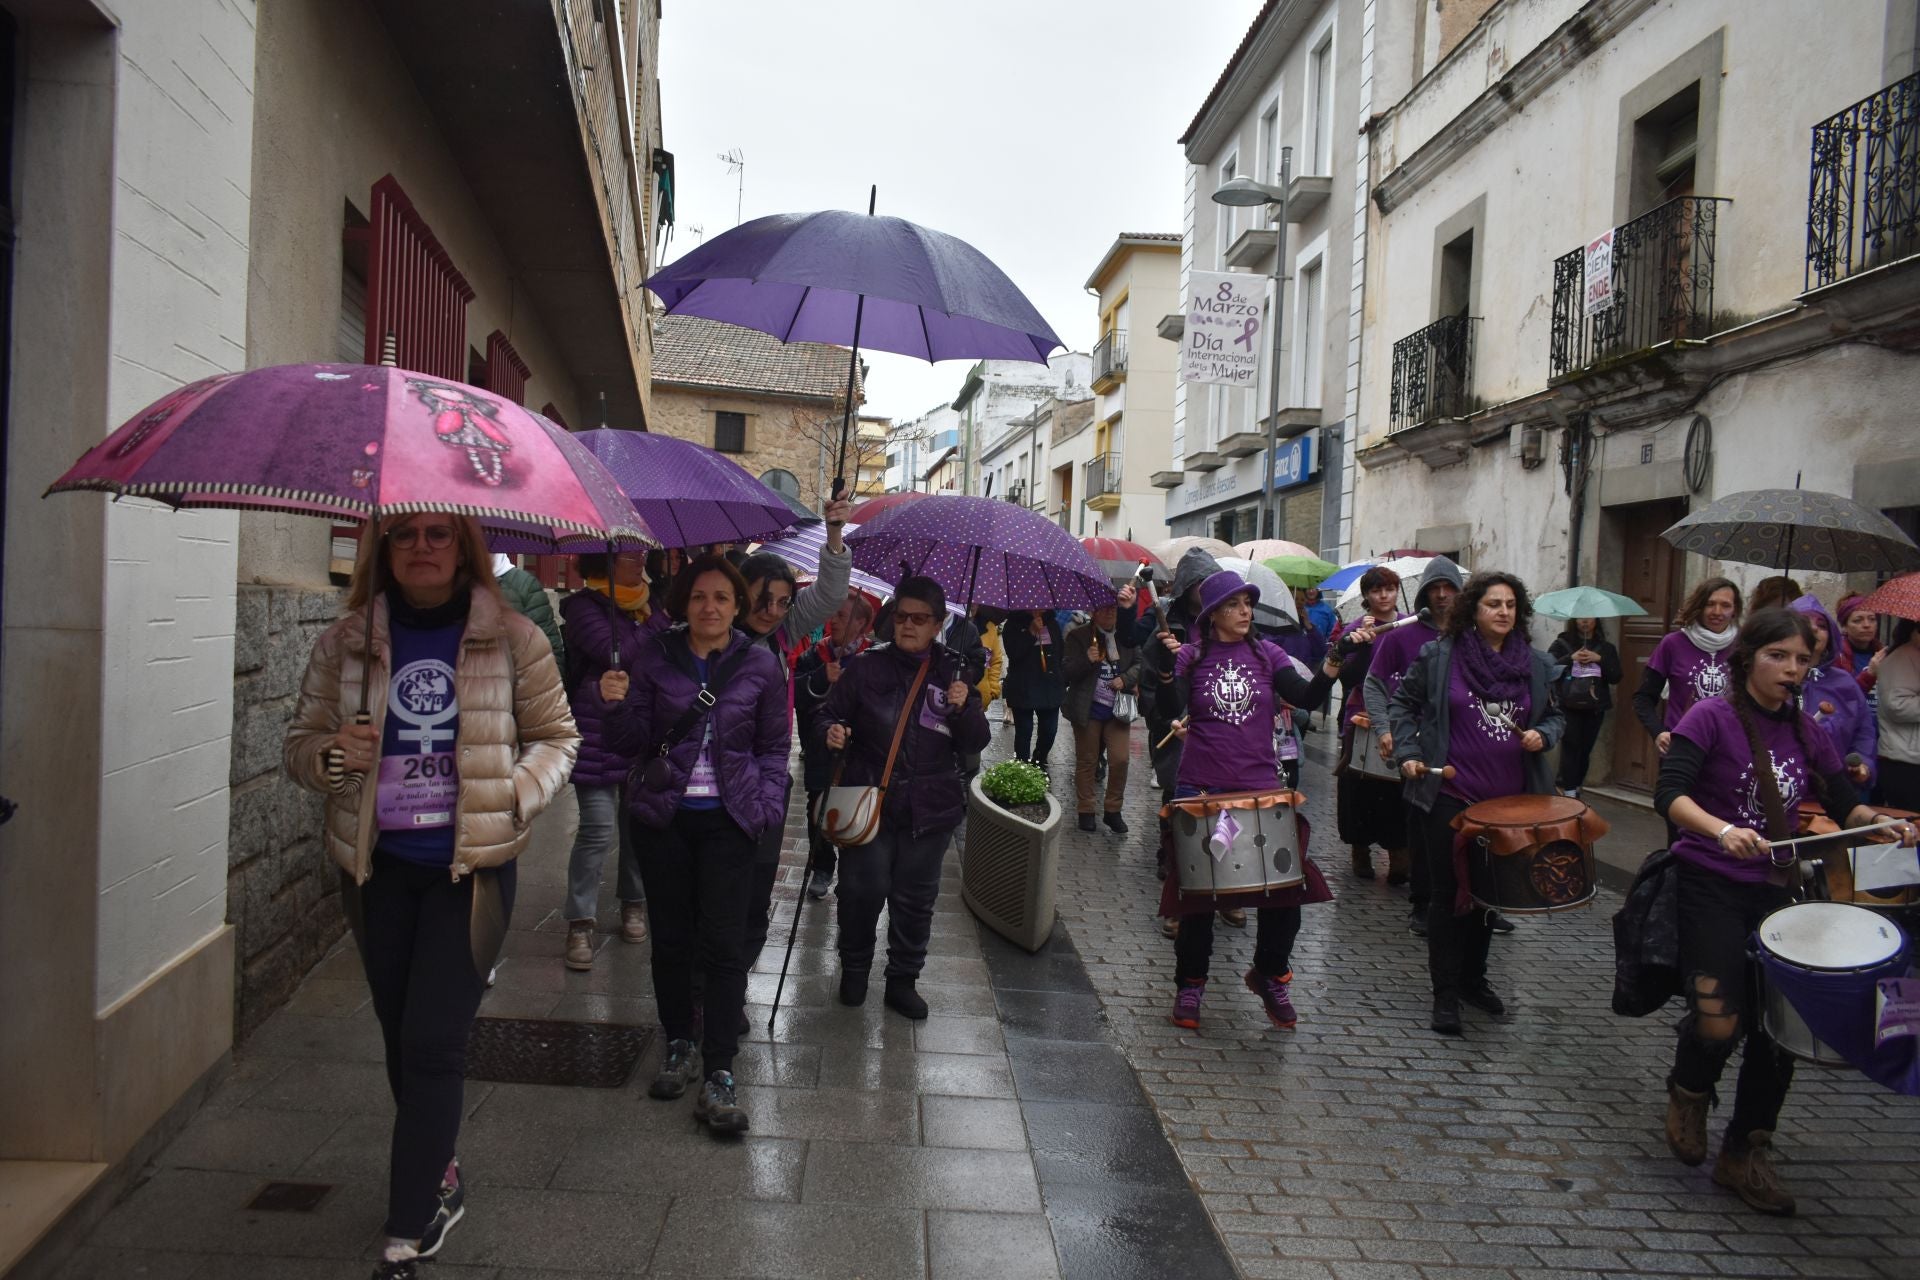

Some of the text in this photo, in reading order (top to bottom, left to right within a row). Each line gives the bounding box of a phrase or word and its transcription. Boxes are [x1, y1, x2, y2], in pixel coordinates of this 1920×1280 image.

[1216, 281, 1247, 303] 8 de
[1193, 296, 1258, 316] Marzo
[1192, 331, 1223, 351] Día
[1187, 348, 1256, 364] Internacional
[1188, 361, 1255, 382] de la Mujer
[403, 755, 454, 780] 260
